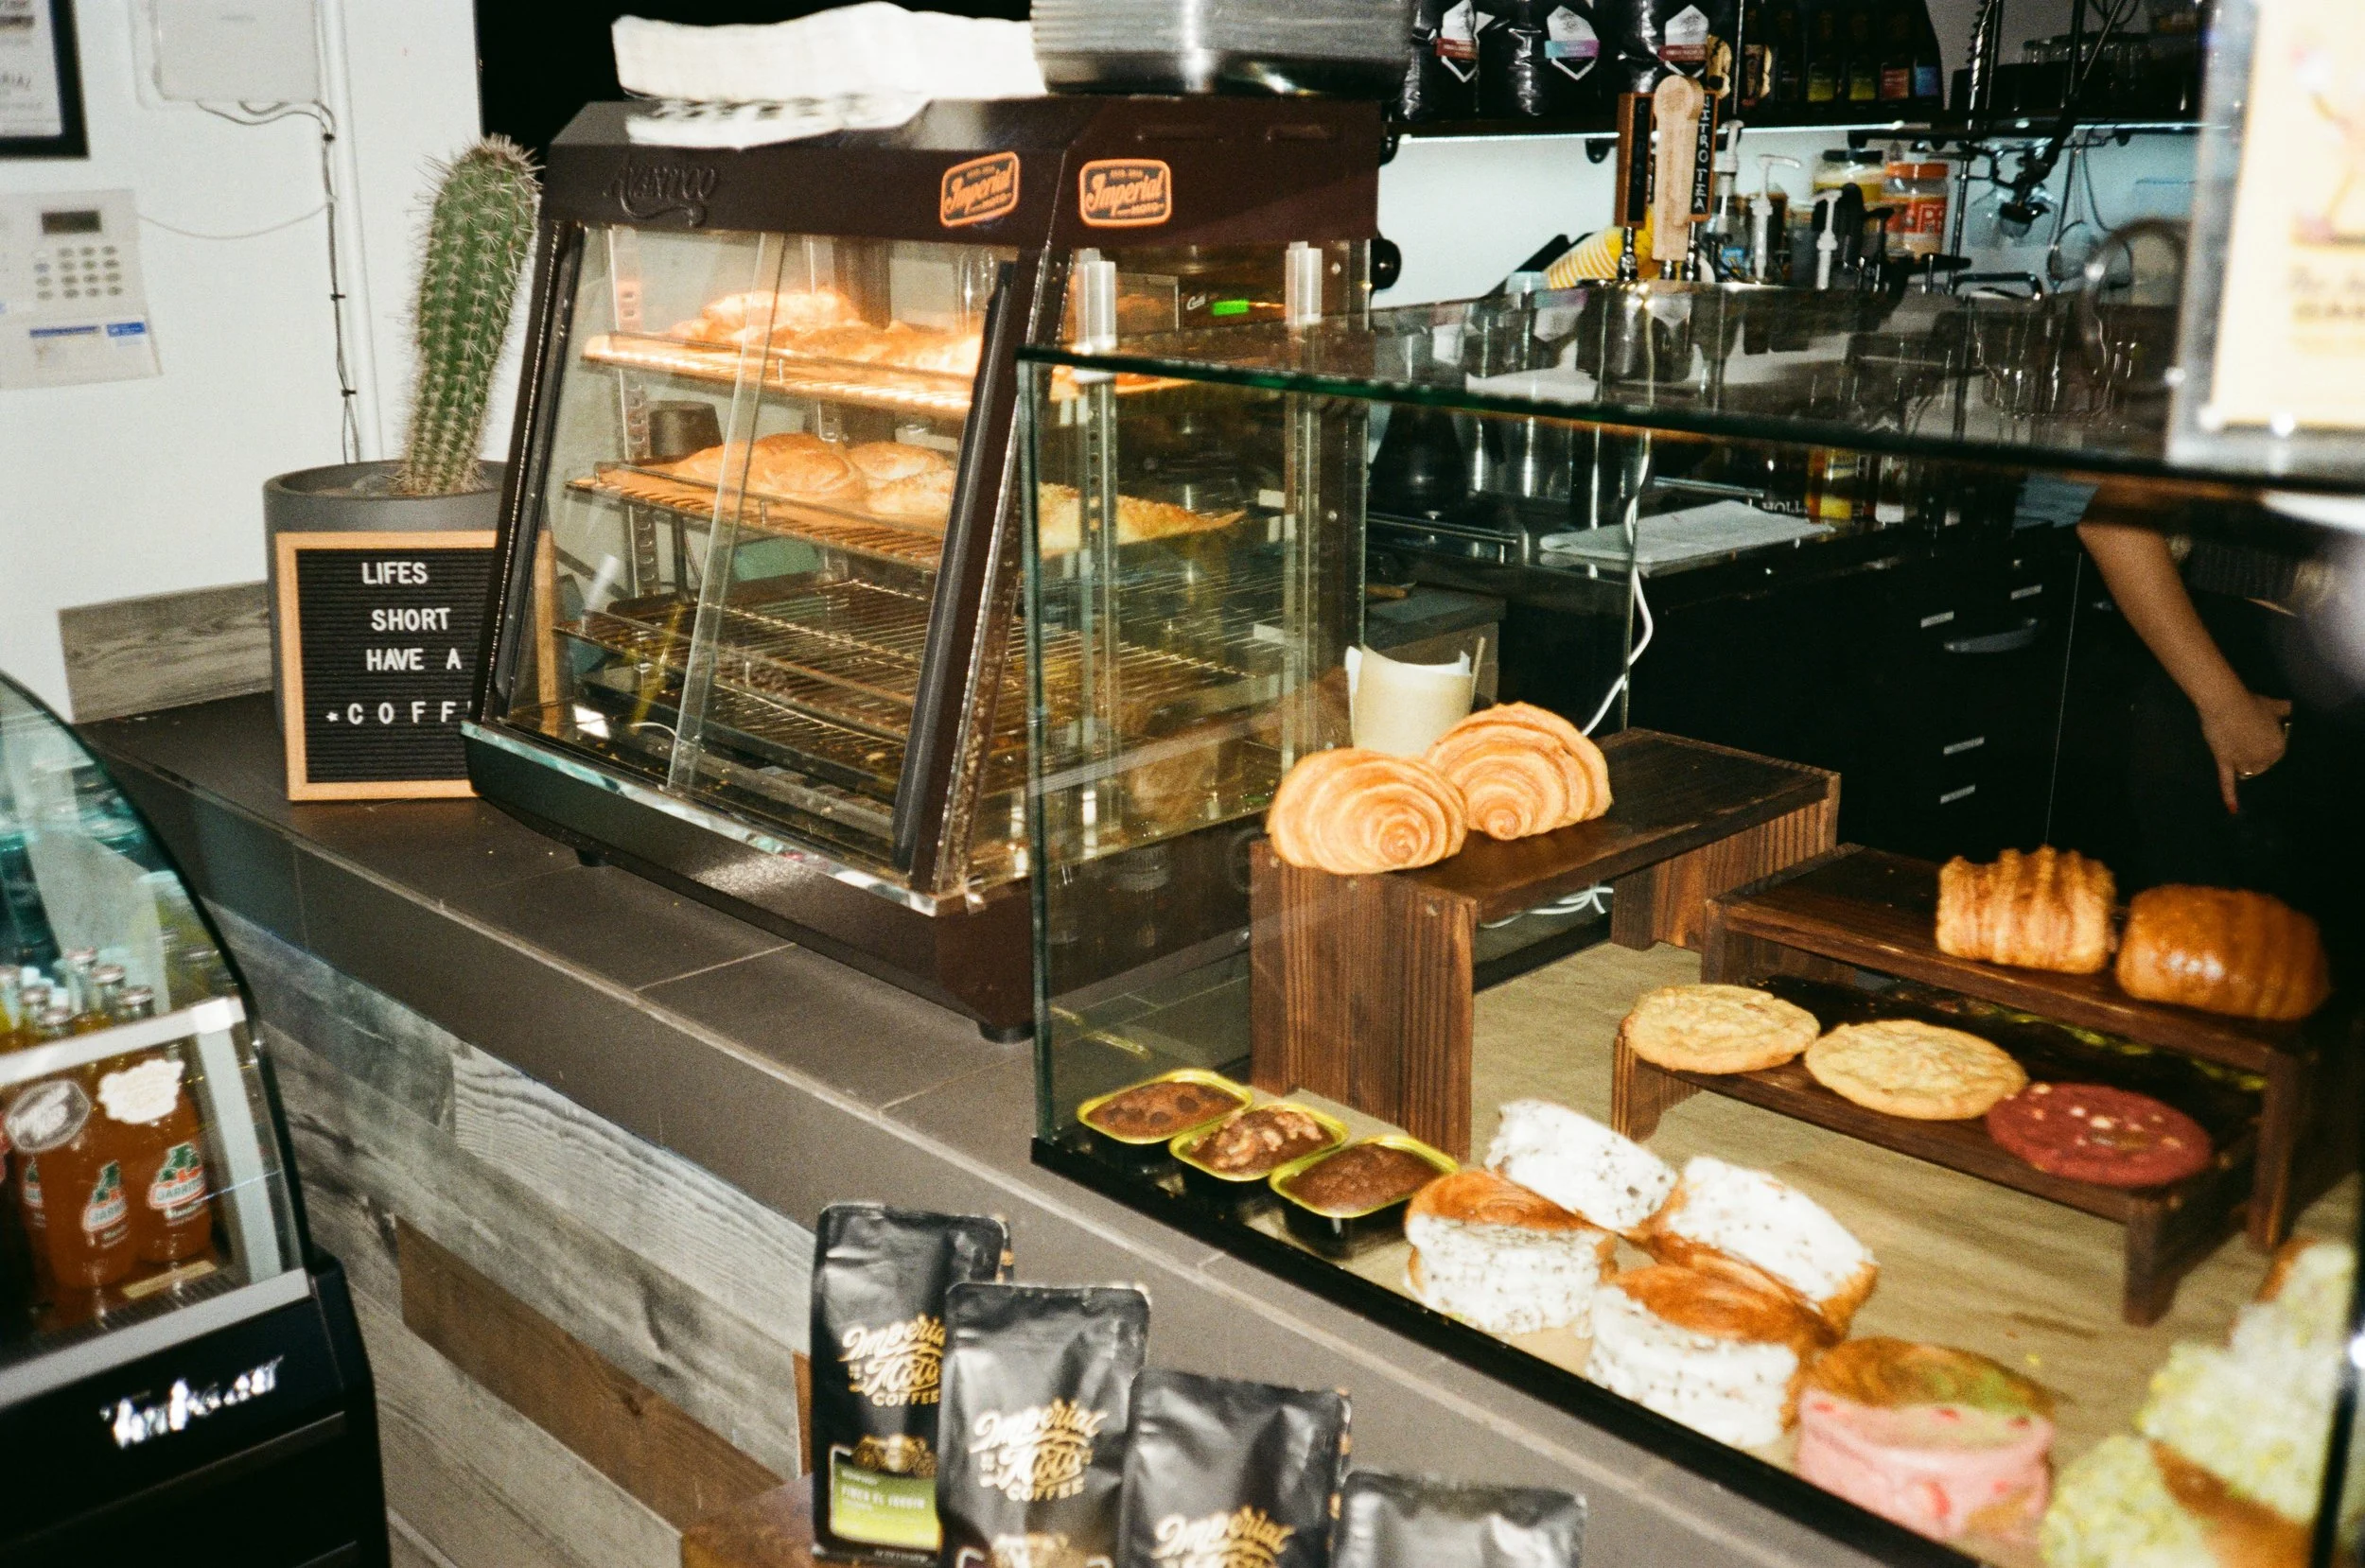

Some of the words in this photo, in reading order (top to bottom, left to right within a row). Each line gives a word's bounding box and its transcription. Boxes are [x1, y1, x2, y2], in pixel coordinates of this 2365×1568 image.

[1085, 169, 1165, 218] Imperial
[1692, 167, 1708, 213] TEA
[361, 561, 429, 585] LIFES
[371, 607, 451, 632] SHORT
[366, 647, 425, 671] HAVE
[446, 647, 463, 671] A
[347, 700, 472, 725] COFF
[836, 1312, 945, 1363] Imperia
[871, 1388, 939, 1407] COFFEE
[968, 1396, 1108, 1454] Imperial
[1006, 1474, 1085, 1502] COFFEE
[1150, 1504, 1297, 1560] Imperial
